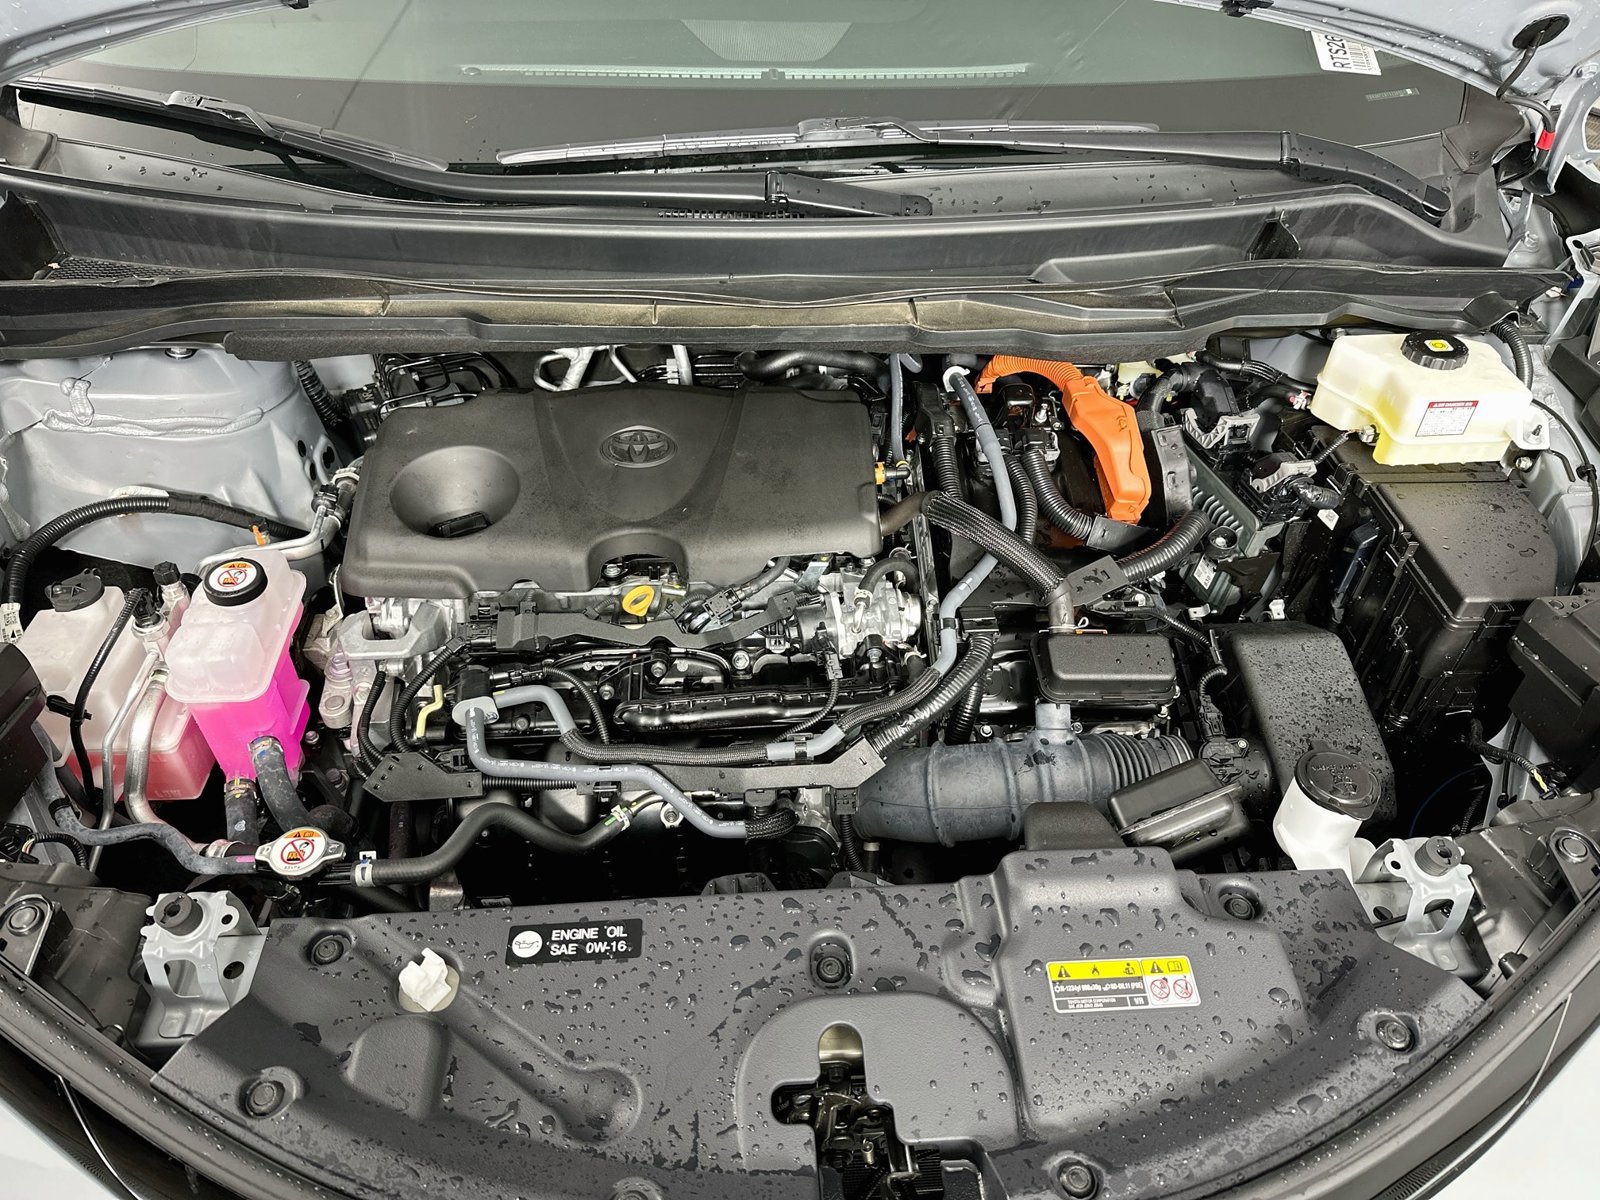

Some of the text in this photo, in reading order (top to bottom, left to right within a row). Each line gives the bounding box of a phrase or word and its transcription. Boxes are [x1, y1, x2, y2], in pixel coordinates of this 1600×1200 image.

[551, 925, 628, 941] ENGINE OIL
[550, 941, 627, 956] SAE 0W-16
